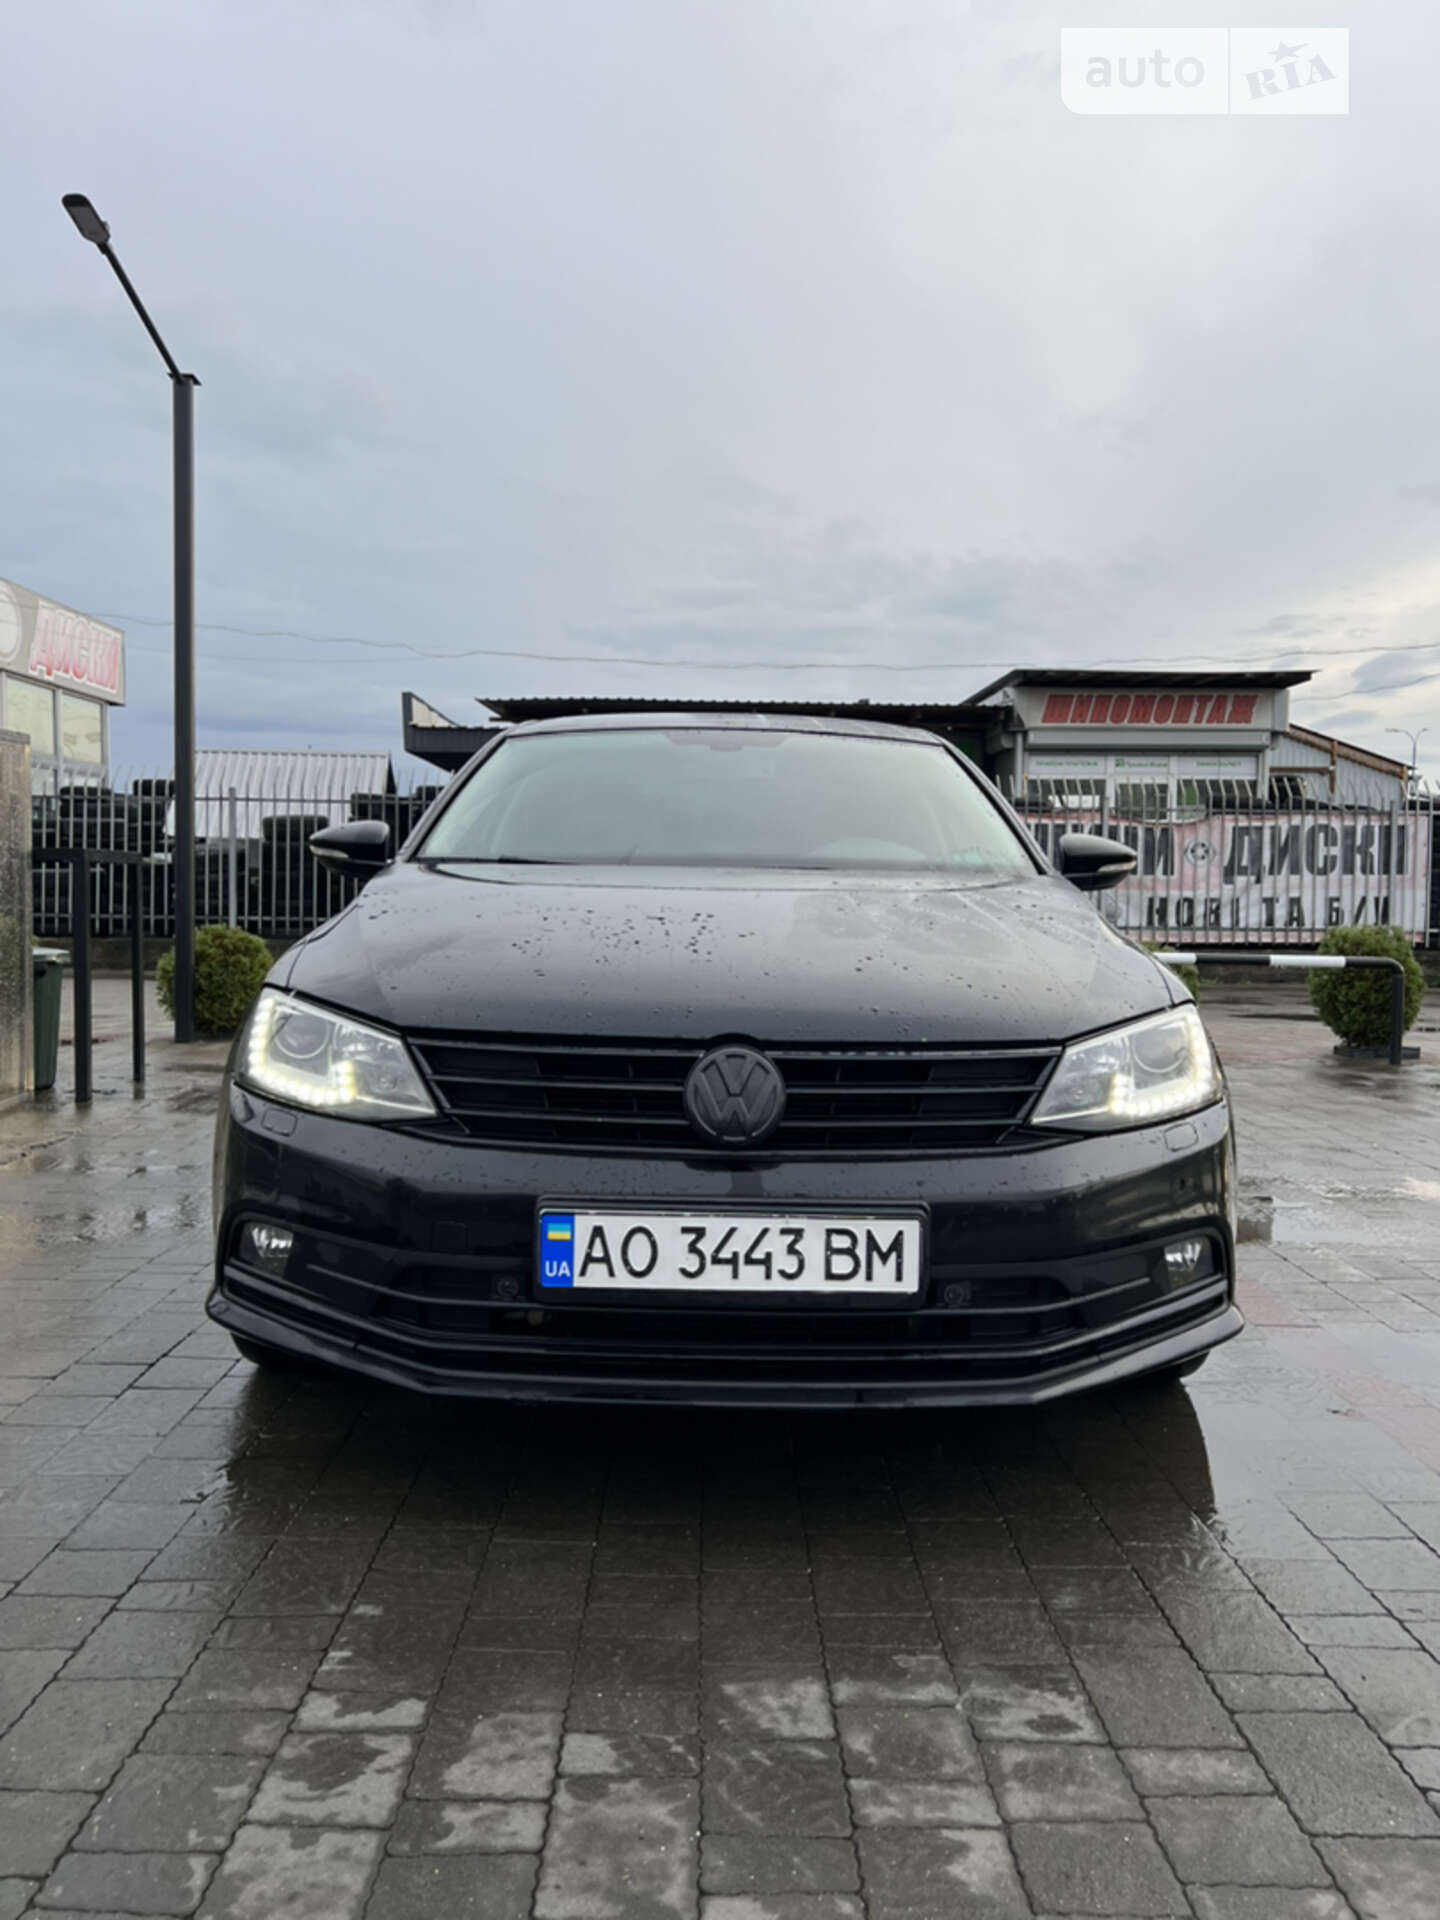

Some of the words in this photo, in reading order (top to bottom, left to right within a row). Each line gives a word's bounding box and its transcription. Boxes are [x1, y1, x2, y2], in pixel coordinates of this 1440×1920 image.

[1041, 694, 1259, 725] ШИНОМОНТАЖ
[1262, 896, 1305, 927] ТА
[545, 1261, 571, 1277] UA
[579, 1225, 659, 1279] AO
[678, 1226, 806, 1281] 3443
[823, 1228, 904, 1283] BM
